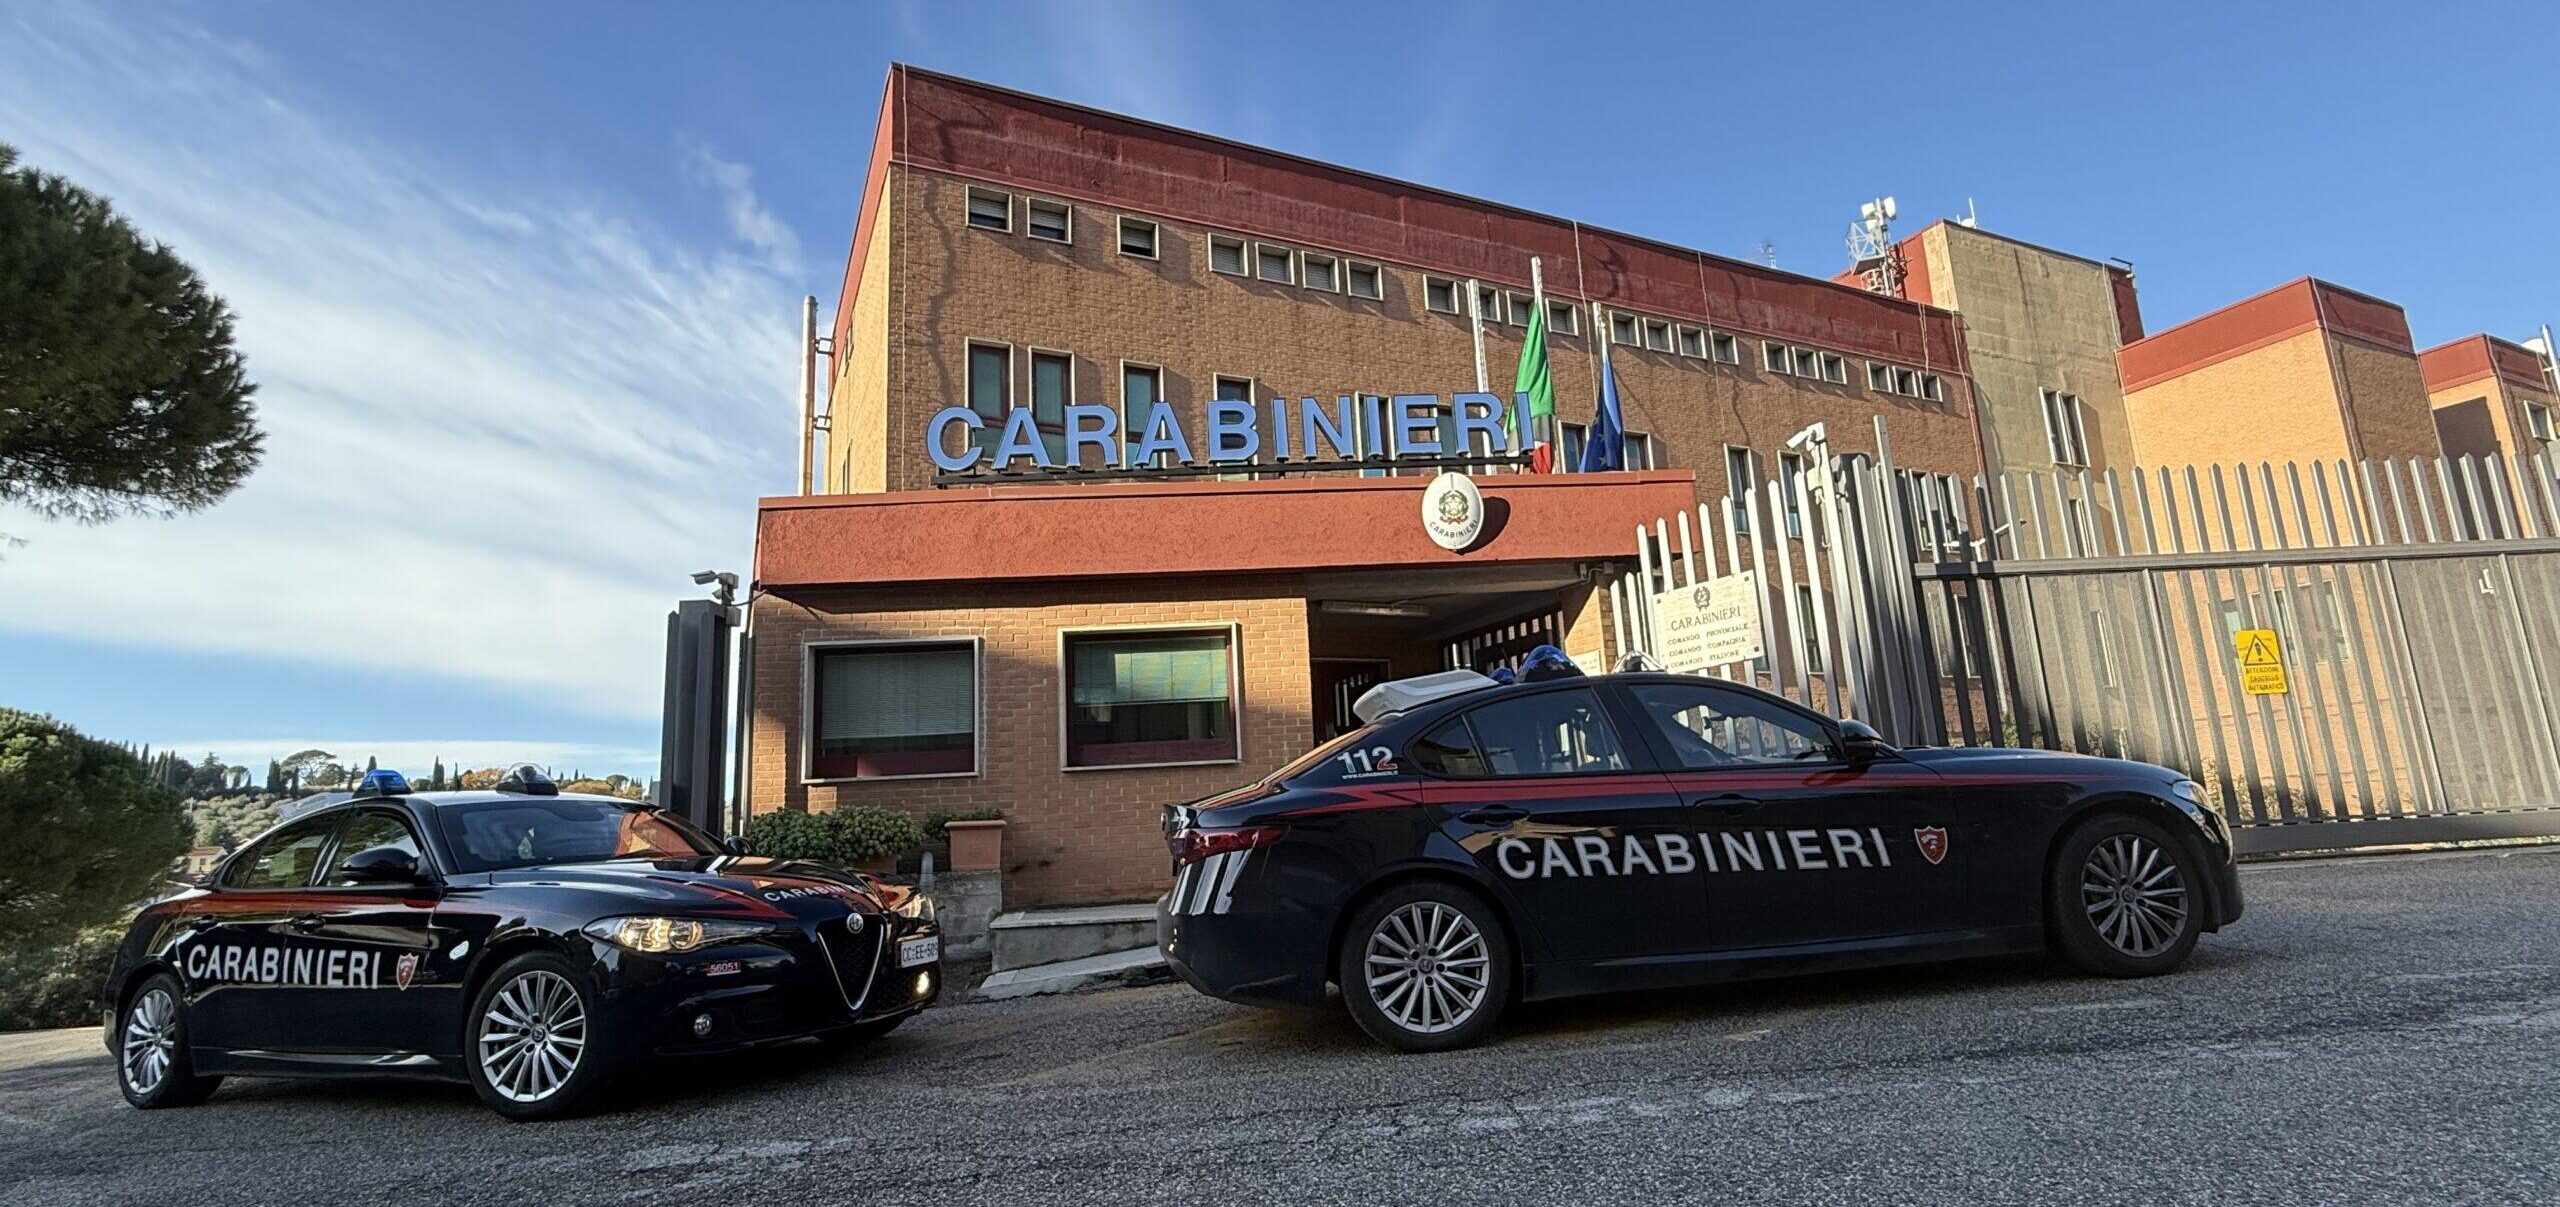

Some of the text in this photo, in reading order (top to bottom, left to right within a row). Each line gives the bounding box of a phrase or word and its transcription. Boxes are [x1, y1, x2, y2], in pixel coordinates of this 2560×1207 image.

[926, 391, 1534, 472] CARABINIERI
[1430, 519, 1479, 538] CARABINIERI
[1671, 606, 1741, 631] CARABINIERI
[1668, 634, 1700, 645] COMANDO
[1669, 645, 1701, 657] COMANDO
[1671, 657, 1702, 668] COMANDO
[1337, 746, 1398, 773] 112
[1497, 827, 1891, 879] CARABINIERI
[187, 944, 381, 989] CARABINIERI
